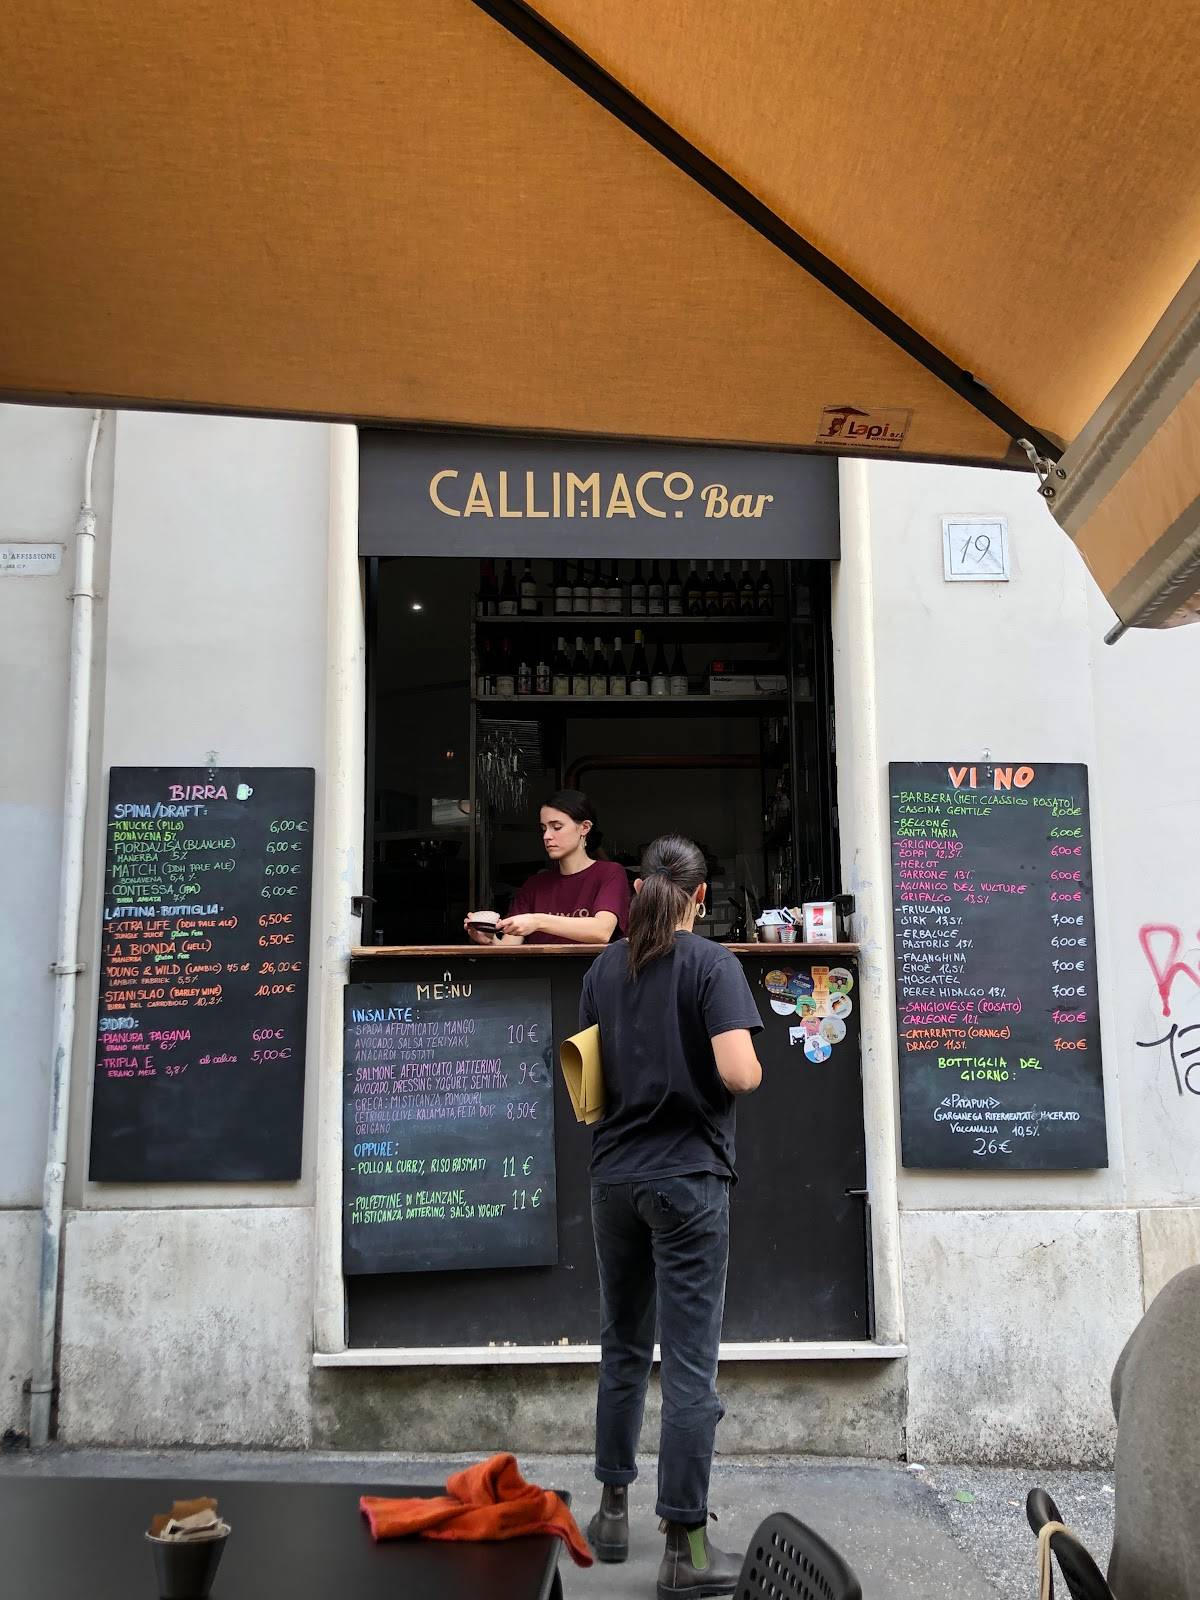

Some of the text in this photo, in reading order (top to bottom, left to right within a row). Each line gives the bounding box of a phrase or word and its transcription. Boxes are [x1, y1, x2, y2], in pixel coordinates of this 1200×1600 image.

[847, 421, 890, 440] Lapi
[429, 470, 774, 518] CALLIMACO Bar
[960, 534, 991, 563] 19
[947, 766, 1035, 791] VINO
[168, 784, 228, 801] BIRRA
[979, 794, 1029, 806] CLASSICO
[898, 804, 941, 815] CASCINA
[946, 806, 993, 816] GENTILE
[114, 831, 161, 841] BONAVENA
[896, 827, 928, 837] SANTA
[183, 837, 236, 851] (BLANCHE)
[117, 853, 159, 863] MANERBA
[162, 862, 186, 875] (DDH
[190, 862, 211, 873] PALE
[213, 859, 236, 872] ALE)
[899, 869, 949, 880] GARRONE
[953, 882, 976, 892] DEL
[980, 882, 1028, 895] VULTURE
[900, 892, 952, 903] GRIFALCO
[146, 921, 172, 932] LIFE
[218, 916, 238, 929] ALE)
[900, 915, 928, 926] SIRK
[128, 942, 176, 956] BIONDA
[181, 939, 212, 953] (HELL)
[902, 939, 950, 949] PASTORIS
[143, 966, 153, 976] &
[155, 963, 181, 976] WILD
[185, 962, 222, 975] (LAMBIC)
[169, 986, 200, 999] (BARLEY
[201, 984, 223, 997] WINE)
[416, 983, 473, 1001] MENU
[902, 987, 937, 998] PEREZ
[939, 987, 985, 998] HIDALGO
[977, 996, 1022, 1014] (ROSATO)
[99, 1016, 140, 1032] SIDRO:
[902, 1013, 958, 1025] CARLEONE
[148, 1029, 192, 1042] PAGANA
[356, 1023, 383, 1036] SPADA
[967, 1025, 1012, 1039] (ORANGE)
[398, 1036, 424, 1049] SALSA
[906, 1040, 939, 1052] DRAGO
[400, 1048, 436, 1061] TOSTATI
[145, 1056, 155, 1069] E
[938, 1057, 1043, 1070] BOTTIGLIA DEL
[355, 1064, 398, 1082] SALMONE
[392, 1078, 432, 1094] DRESSING
[470, 1075, 491, 1090] SEMI
[492, 1074, 508, 1089] MIX
[355, 1122, 391, 1136] ORIGANO
[353, 1142, 400, 1158] OPPURE:
[384, 1161, 394, 1174] AL
[396, 1159, 425, 1176] CURRY,
[430, 1158, 451, 1173] RISO
[452, 1157, 487, 1173] BASMATI
[450, 1205, 475, 1219] SALSA
[477, 1203, 507, 1219] YOGURT
